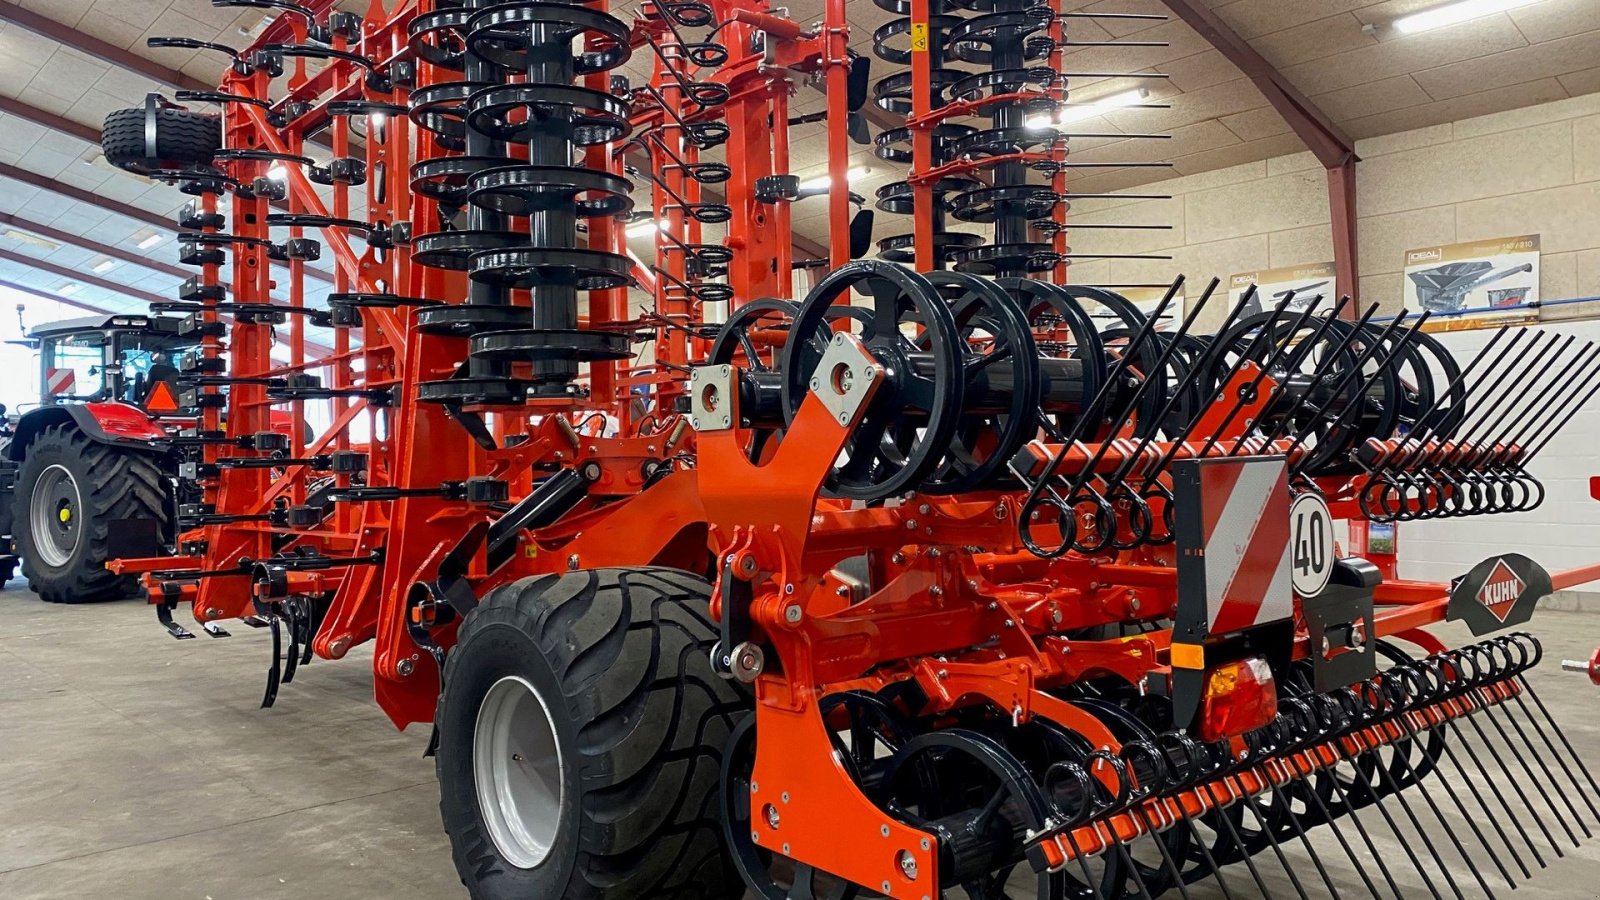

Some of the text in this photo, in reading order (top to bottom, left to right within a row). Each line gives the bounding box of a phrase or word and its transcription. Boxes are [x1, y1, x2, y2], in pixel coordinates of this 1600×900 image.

[1411, 250, 1438, 260] IDEAL
[1294, 510, 1325, 576] 40
[1484, 578, 1518, 606] KUHN
